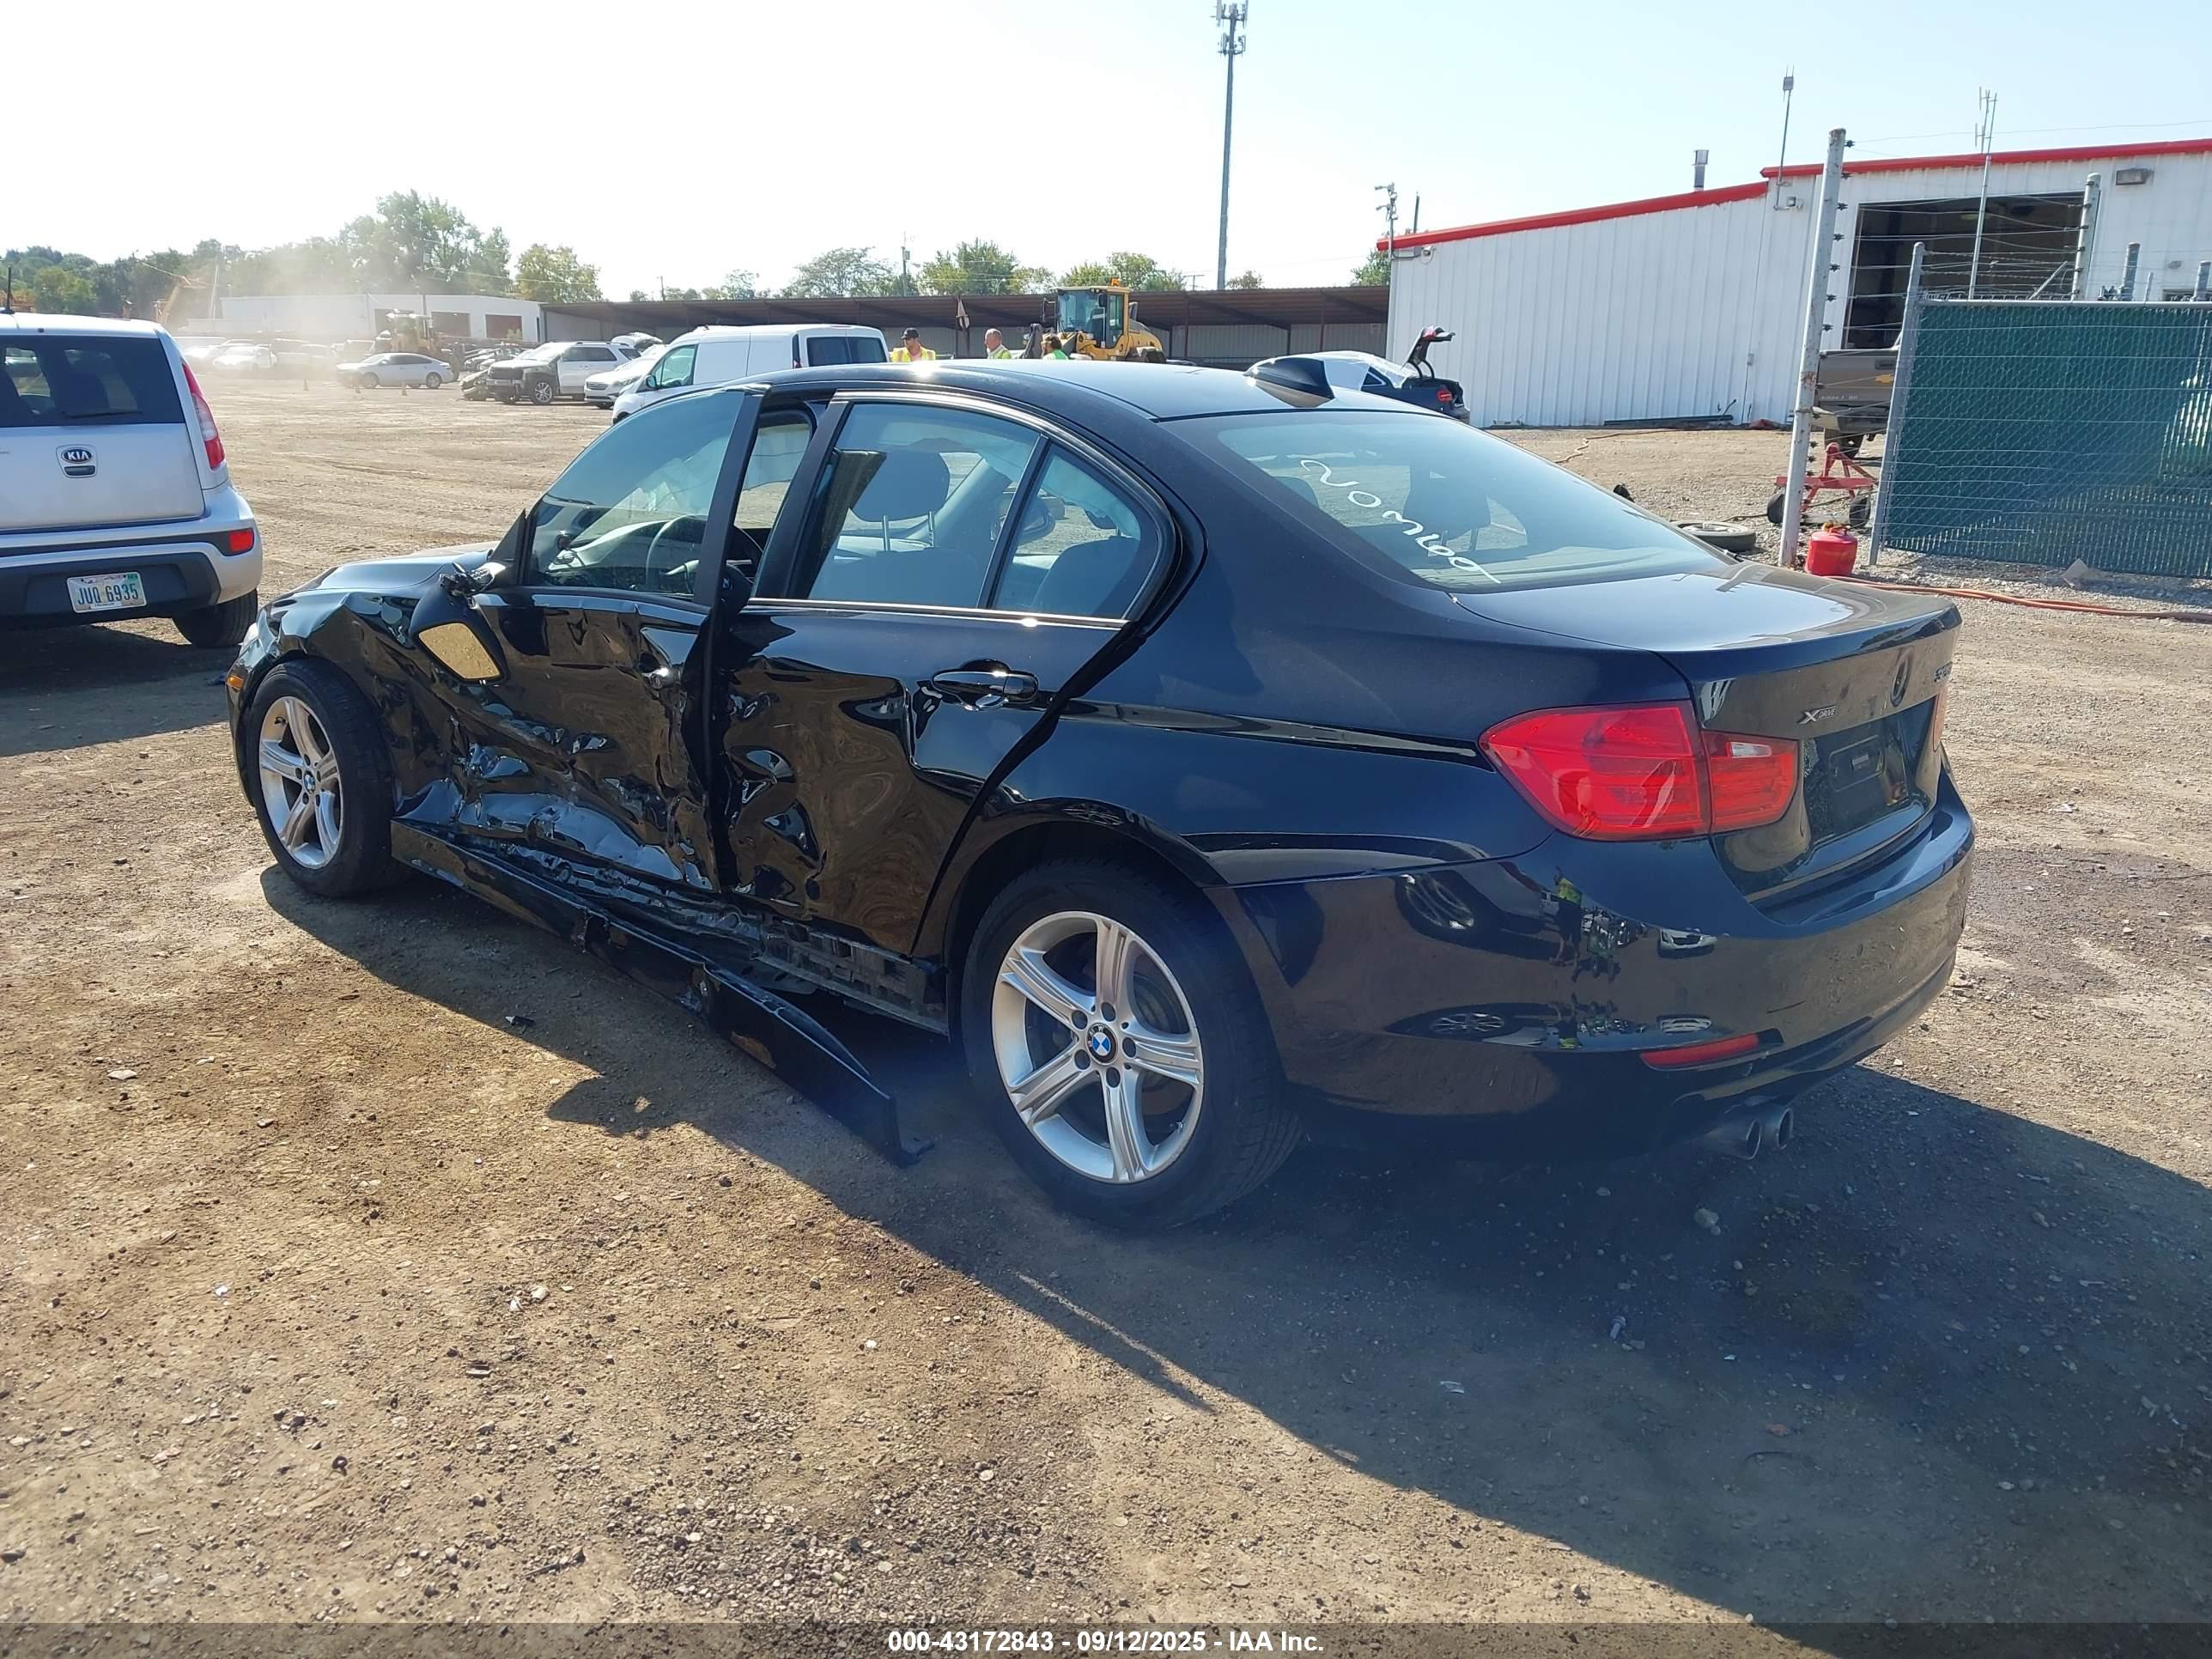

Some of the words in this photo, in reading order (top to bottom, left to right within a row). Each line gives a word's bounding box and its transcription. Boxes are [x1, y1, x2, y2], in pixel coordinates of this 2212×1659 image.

[67, 451, 89, 460] KIA
[77, 586, 102, 606] JUQ
[106, 583, 139, 603] 6935
